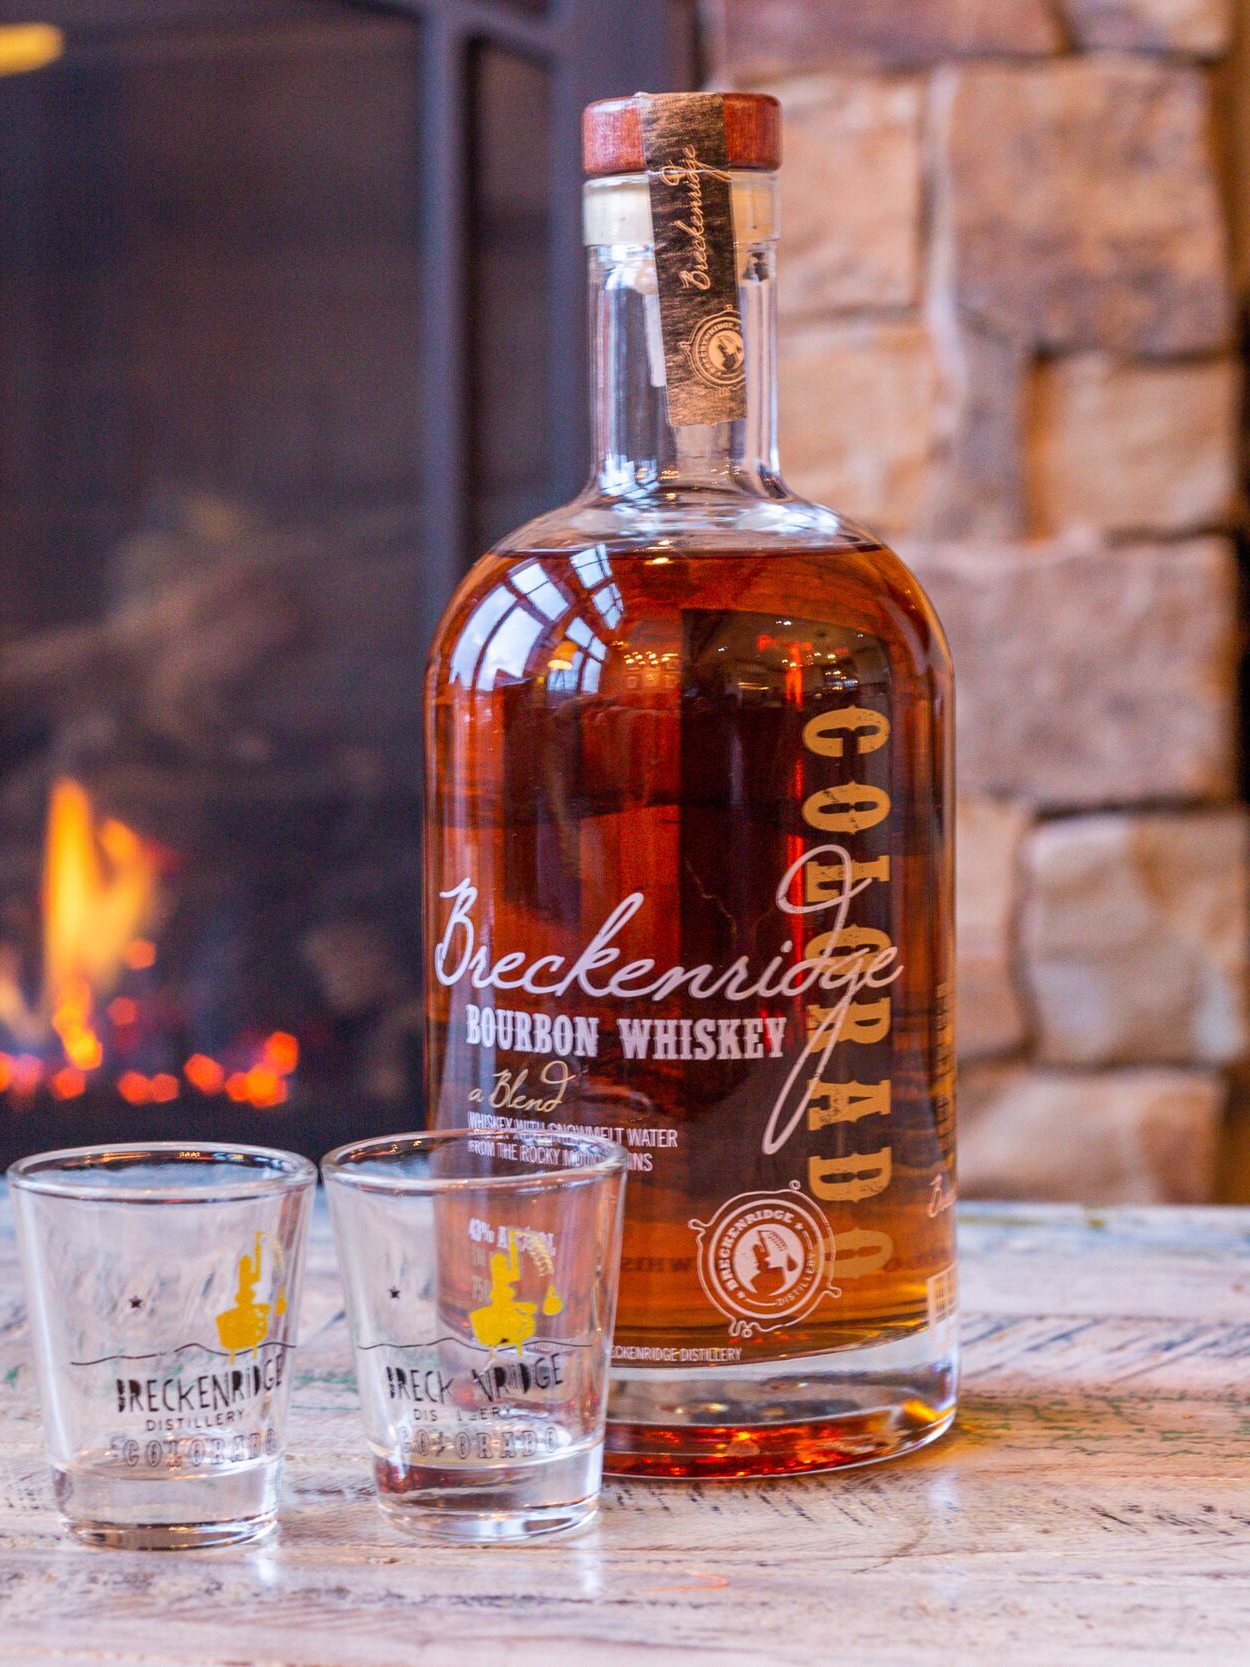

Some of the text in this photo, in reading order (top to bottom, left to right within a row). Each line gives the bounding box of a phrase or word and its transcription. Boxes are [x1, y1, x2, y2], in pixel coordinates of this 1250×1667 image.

[658, 143, 732, 291] Breckenridge
[434, 844, 904, 1155] Breckenridge
[801, 704, 893, 1280] COLORADO
[465, 1004, 787, 1061] BOURBON WHISKEY
[489, 1060, 576, 1113] Blend
[467, 1111, 512, 1131] WHISKEY
[626, 1129, 678, 1149] WATER
[468, 1140, 495, 1157] FROM
[497, 1142, 518, 1161] THE
[519, 1145, 561, 1165] ROCKY
[717, 1209, 815, 1306] BRECKENRIDGE DISTILLERY
[386, 1353, 564, 1404] BRECKNRIDGE
[678, 1347, 743, 1362] DISTILLERY
[146, 1408, 246, 1432] DISTILLERY
